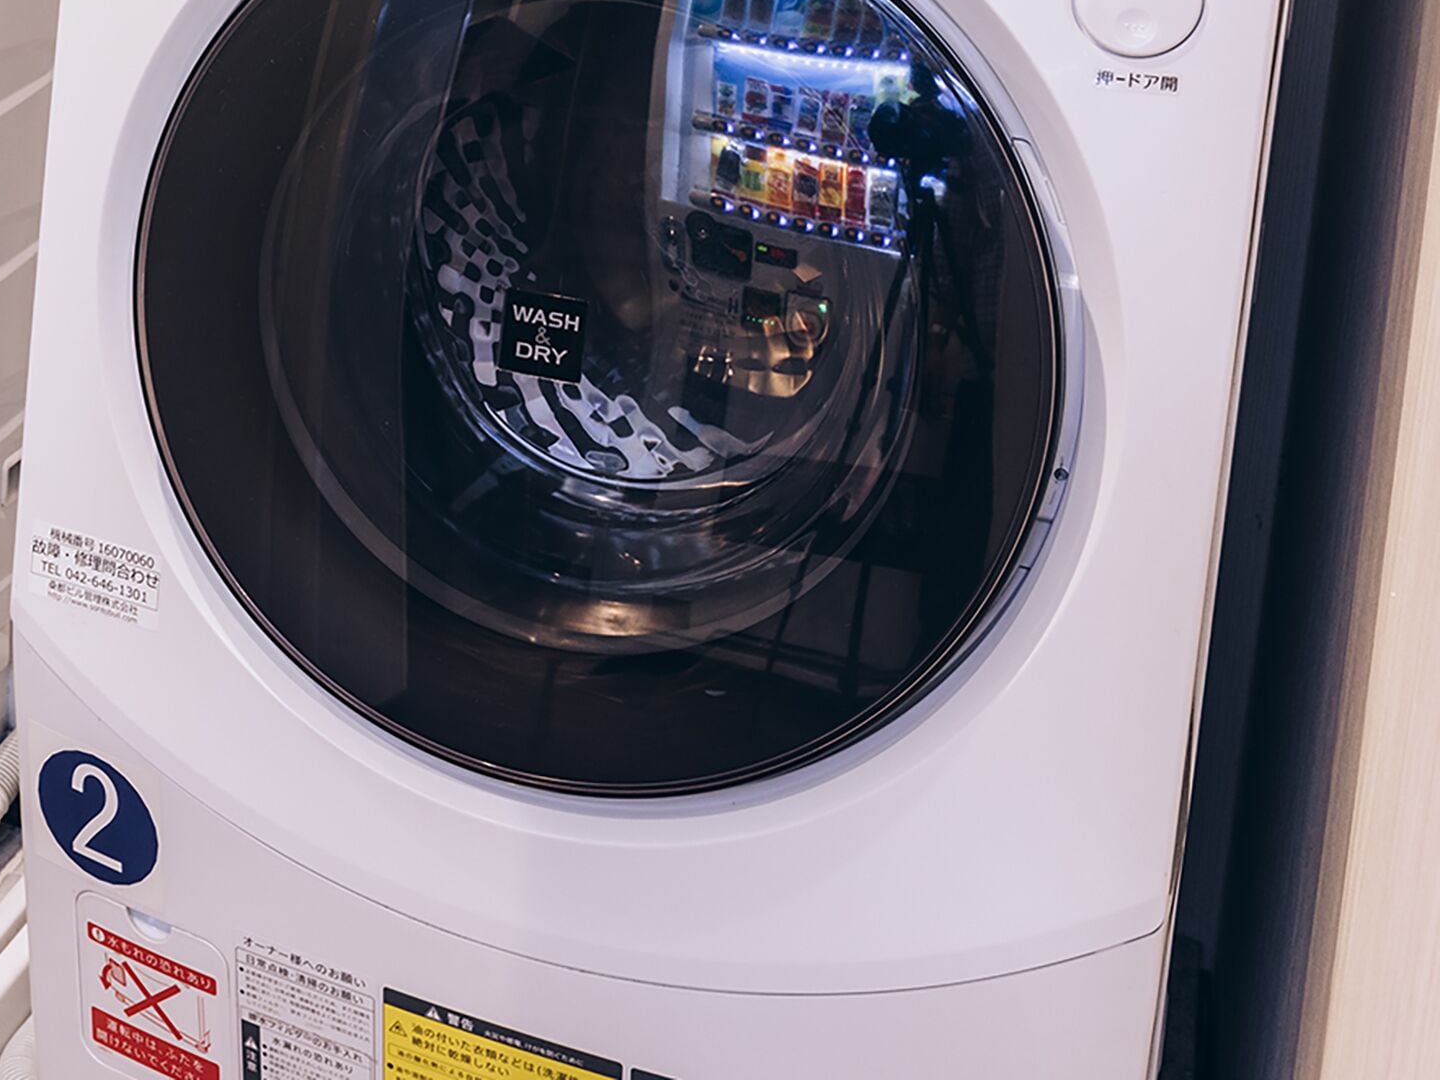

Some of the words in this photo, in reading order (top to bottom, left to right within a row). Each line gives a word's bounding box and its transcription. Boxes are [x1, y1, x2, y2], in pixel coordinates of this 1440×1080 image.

[512, 304, 580, 332] WASH
[535, 326, 551, 346] &
[515, 341, 569, 365] DRY
[50, 527, 95, 552] 機械番号
[98, 542, 155, 569] 16070060
[41, 560, 61, 577] TEL
[64, 567, 148, 604] 042-646-1301
[71, 763, 123, 873] 2
[106, 935, 211, 990] 水もれの恐れあり
[243, 936, 367, 988] オーナー様へのお願い
[447, 1012, 475, 1032] 警告
[411, 1036, 510, 1077] 絶対に乾燥しない
